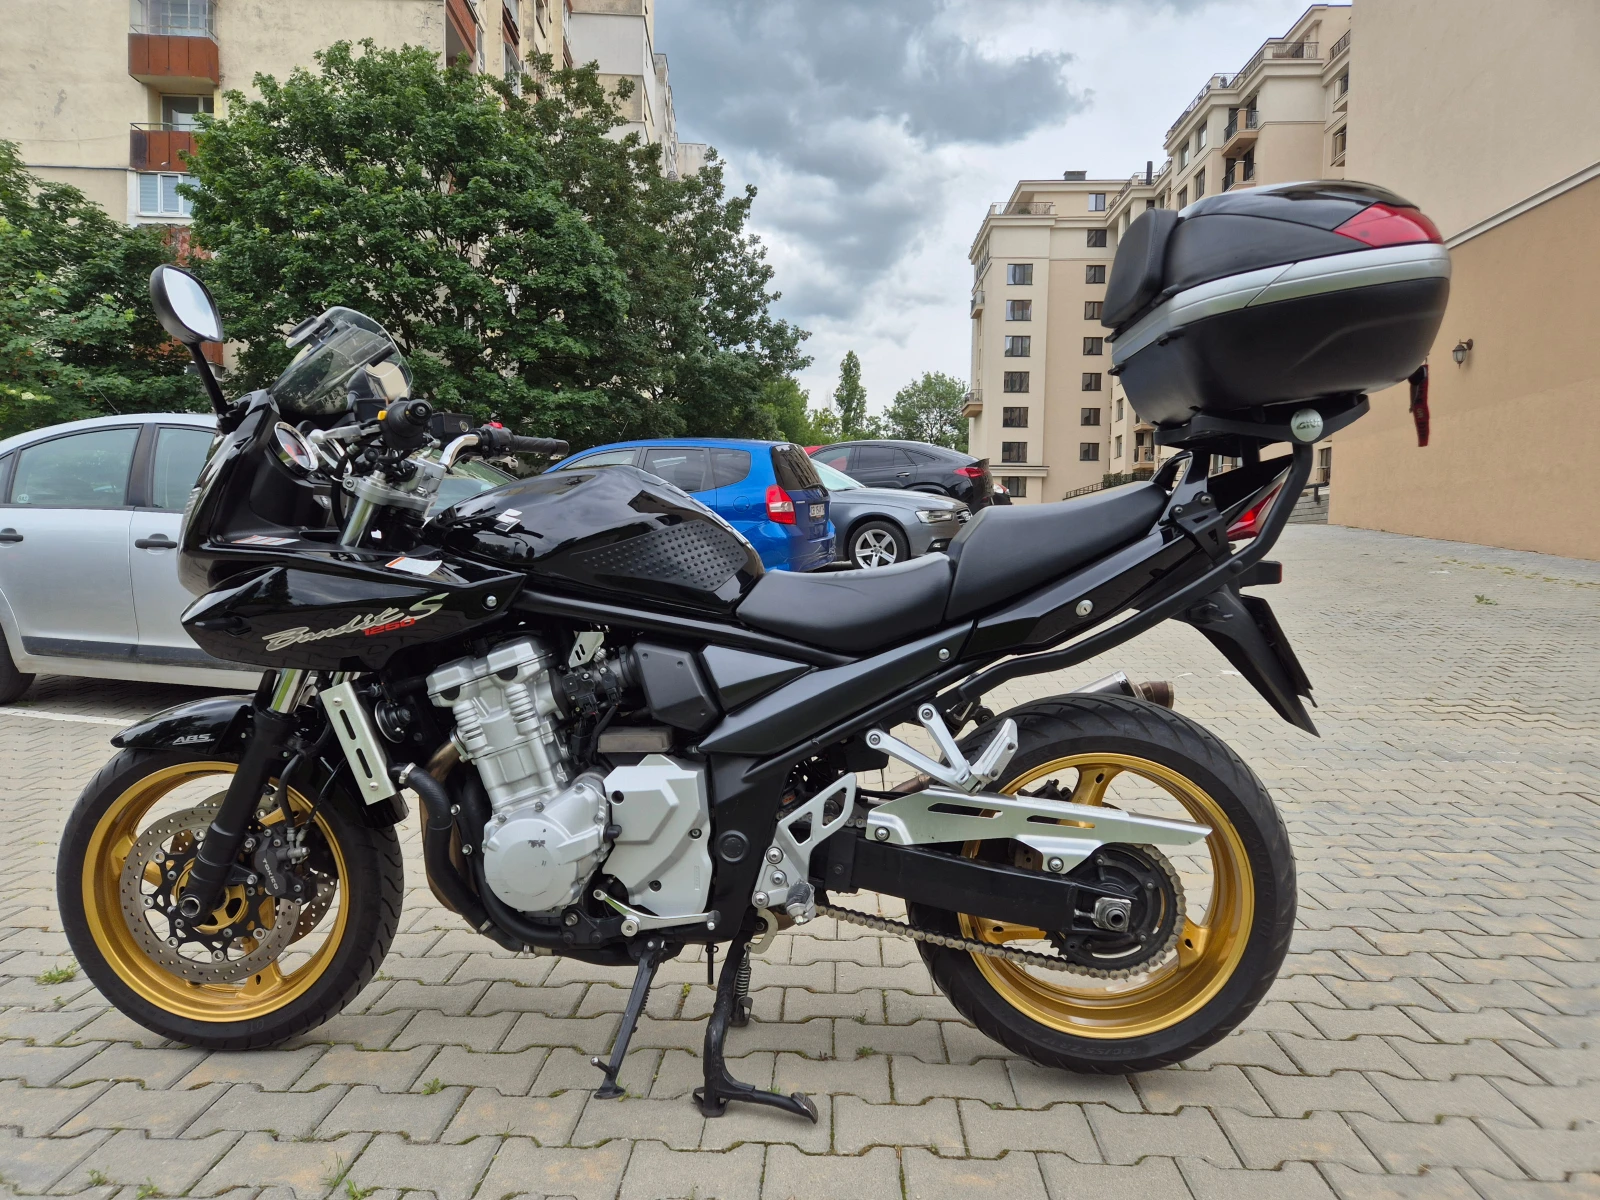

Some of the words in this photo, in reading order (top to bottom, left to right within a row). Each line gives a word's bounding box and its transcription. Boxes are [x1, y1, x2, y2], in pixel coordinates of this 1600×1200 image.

[262, 607, 405, 651] Bandit
[400, 592, 449, 622] S
[362, 617, 416, 636] 1250
[172, 733, 212, 746] ABS
[262, 857, 279, 890] TOKICO
